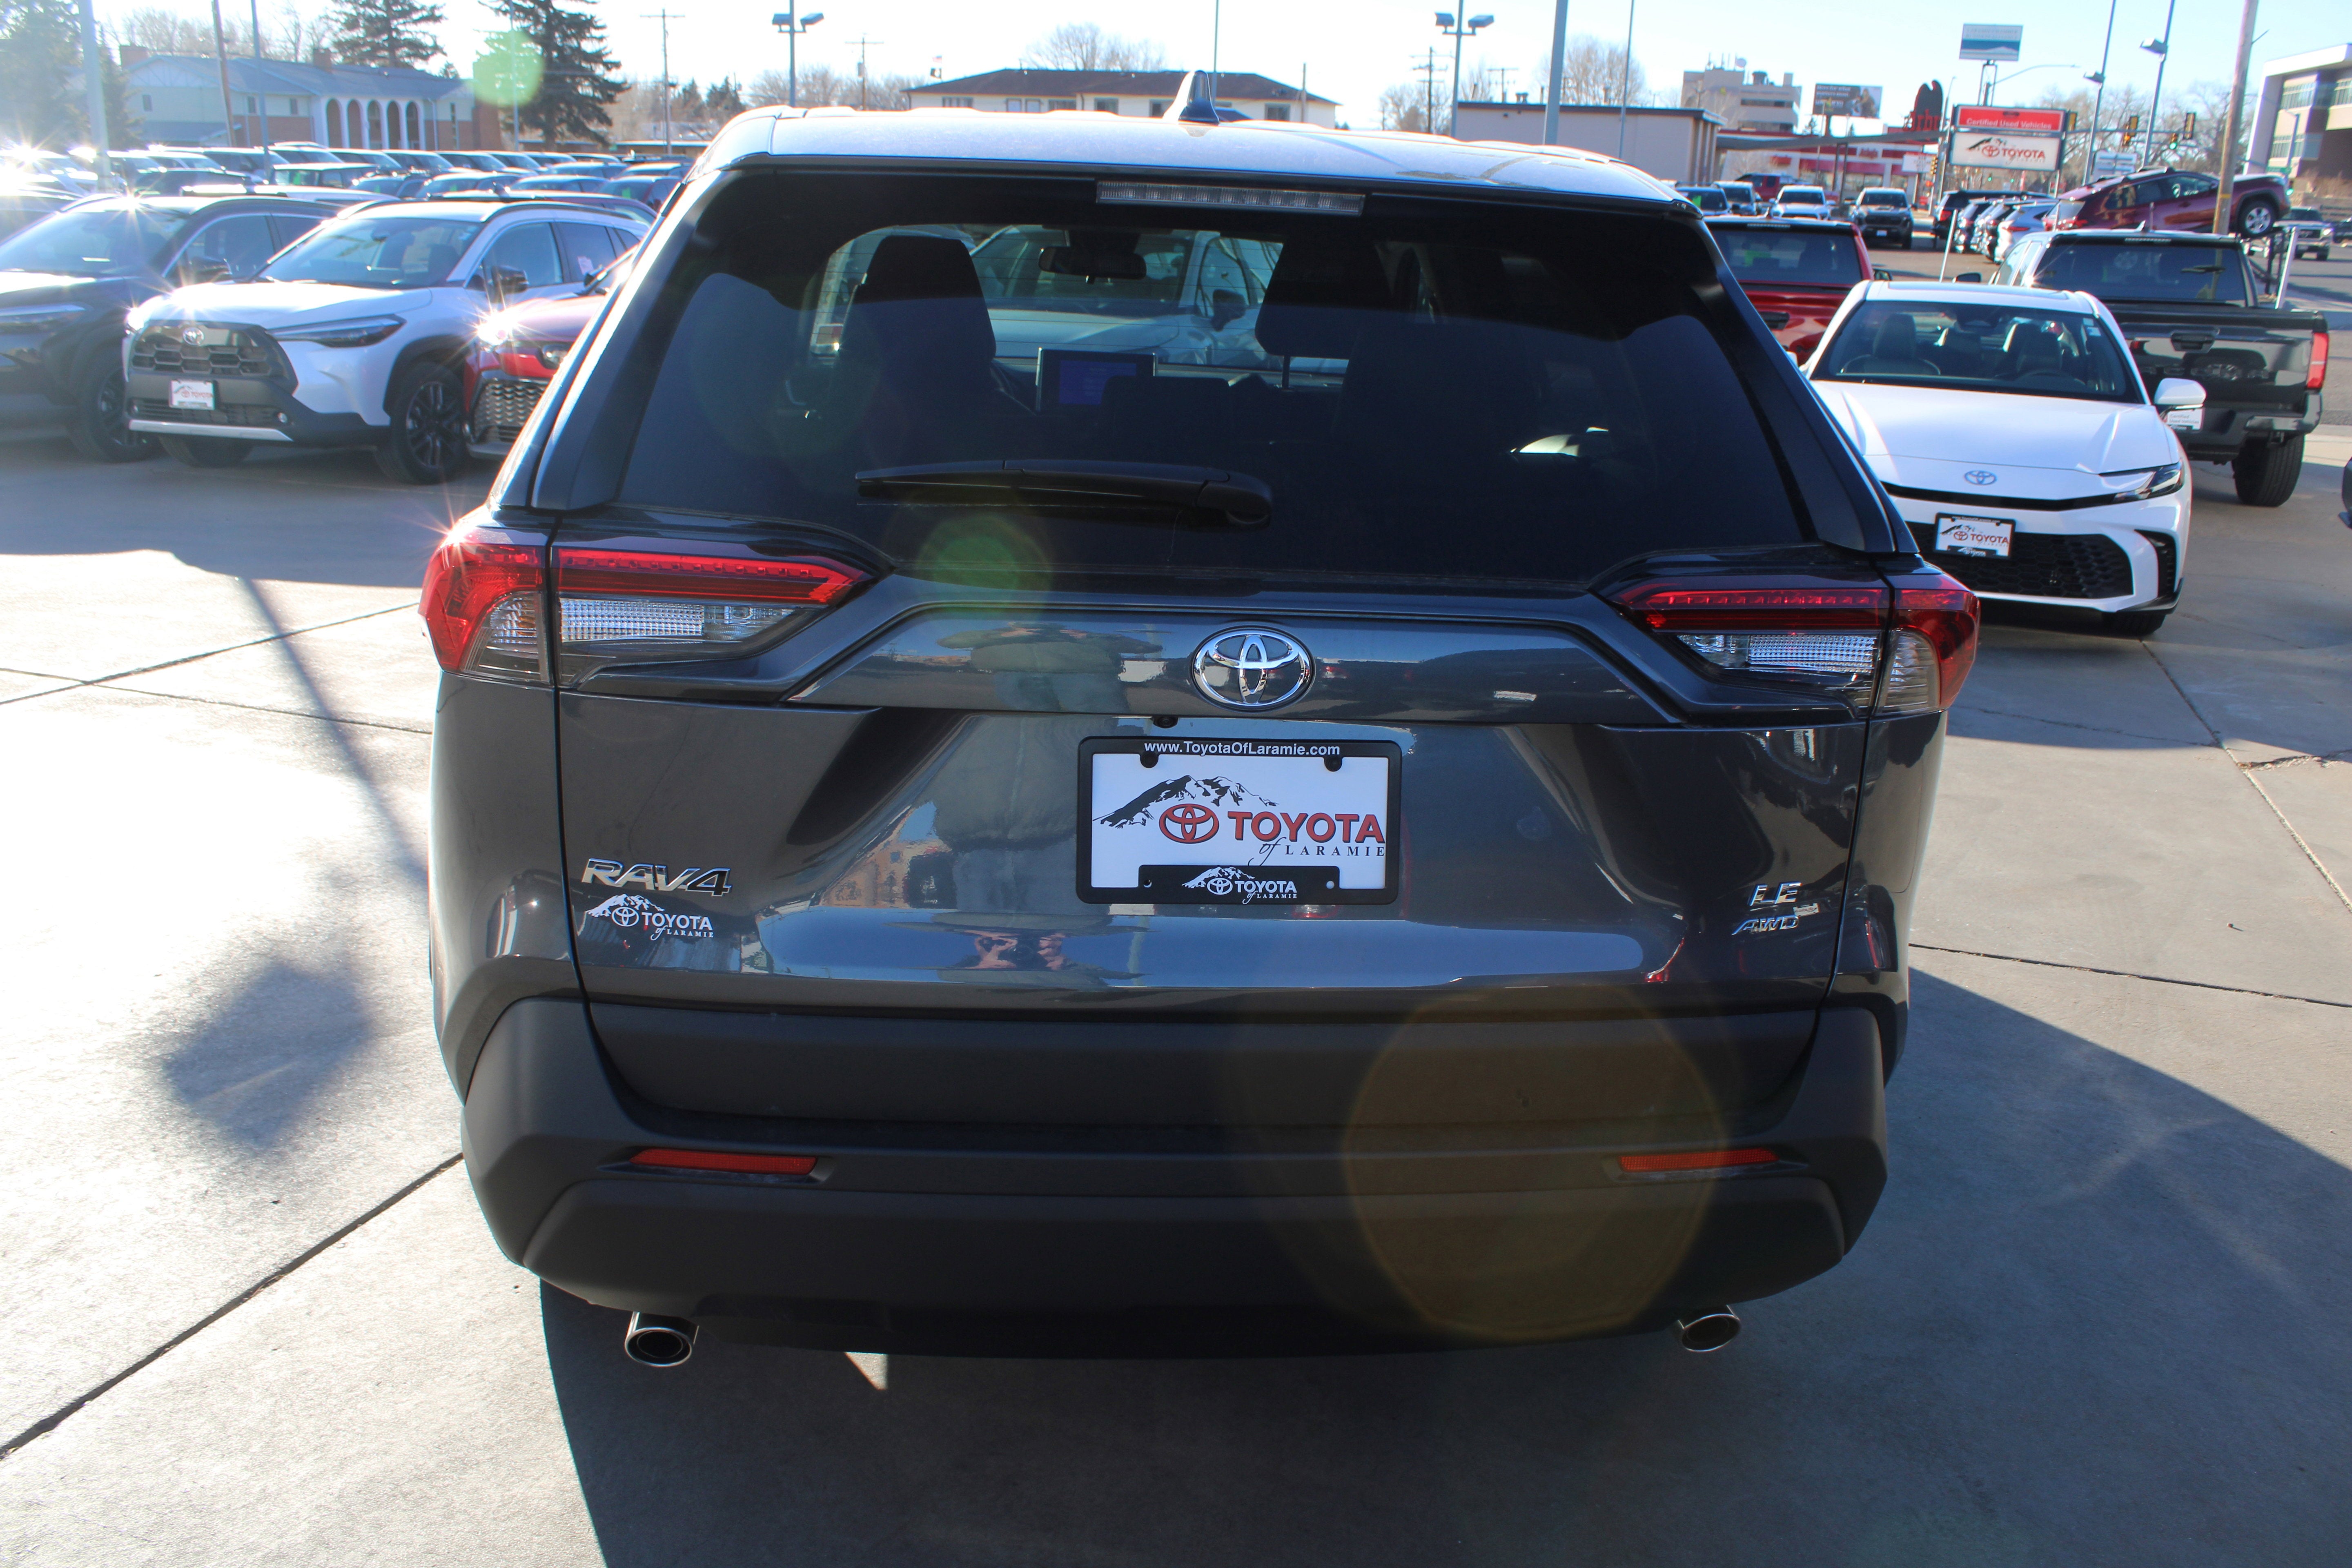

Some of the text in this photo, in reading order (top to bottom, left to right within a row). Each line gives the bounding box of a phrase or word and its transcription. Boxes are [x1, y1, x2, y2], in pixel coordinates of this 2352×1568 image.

[1966, 118, 1998, 127] Certified
[2021, 121, 2052, 129] Vehicles
[2002, 148, 2045, 159] TOYOTA
[1970, 534, 2009, 544] TOYOTA
[1144, 741, 1340, 756] www.ToyotaOfLaramie.com
[1227, 811, 1385, 844] TOYOTA
[1248, 836, 1385, 866] of LARAMIE
[581, 858, 732, 897] RAV4
[1234, 880, 1297, 893] TOYOTA
[1747, 881, 1803, 906] LE
[1242, 891, 1258, 905] of
[641, 911, 713, 931] TOYOTA
[1731, 915, 1800, 935] AWD
[650, 925, 714, 941] of LARAMIE
